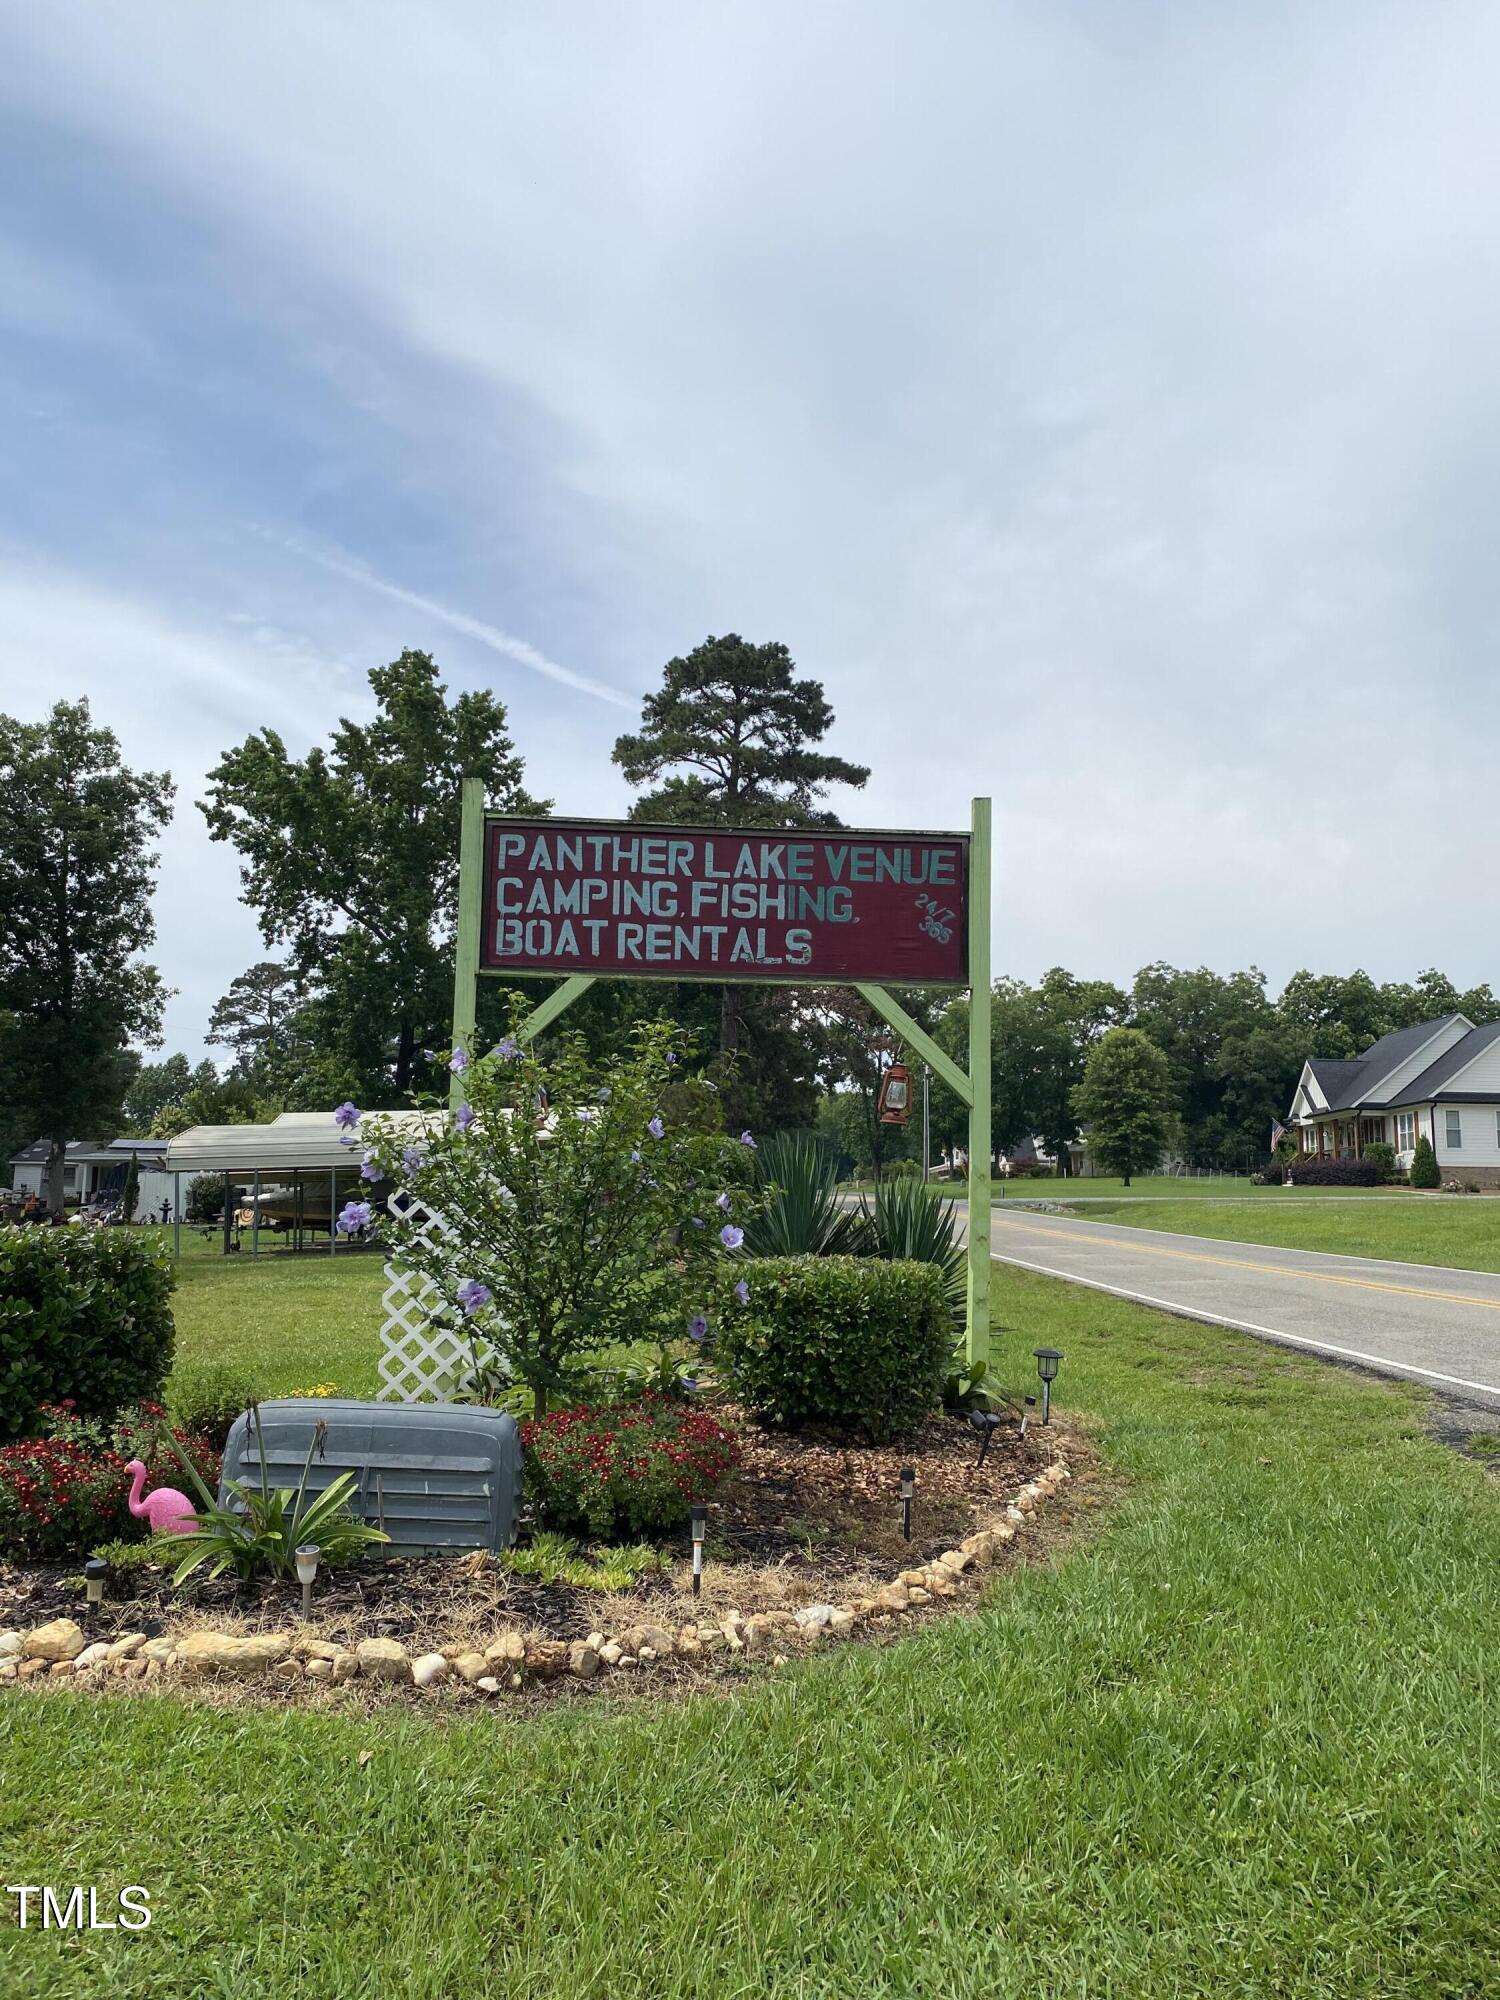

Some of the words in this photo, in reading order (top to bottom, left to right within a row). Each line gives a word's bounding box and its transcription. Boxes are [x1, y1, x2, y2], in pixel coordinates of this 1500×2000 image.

[498, 834, 695, 877] PANTHER
[705, 842, 815, 880] LAKE
[824, 845, 956, 885] VENUE
[914, 893, 956, 923] 24/7
[495, 918, 609, 958] BOAT
[617, 922, 813, 965] RENTALS
[918, 915, 953, 944] 365
